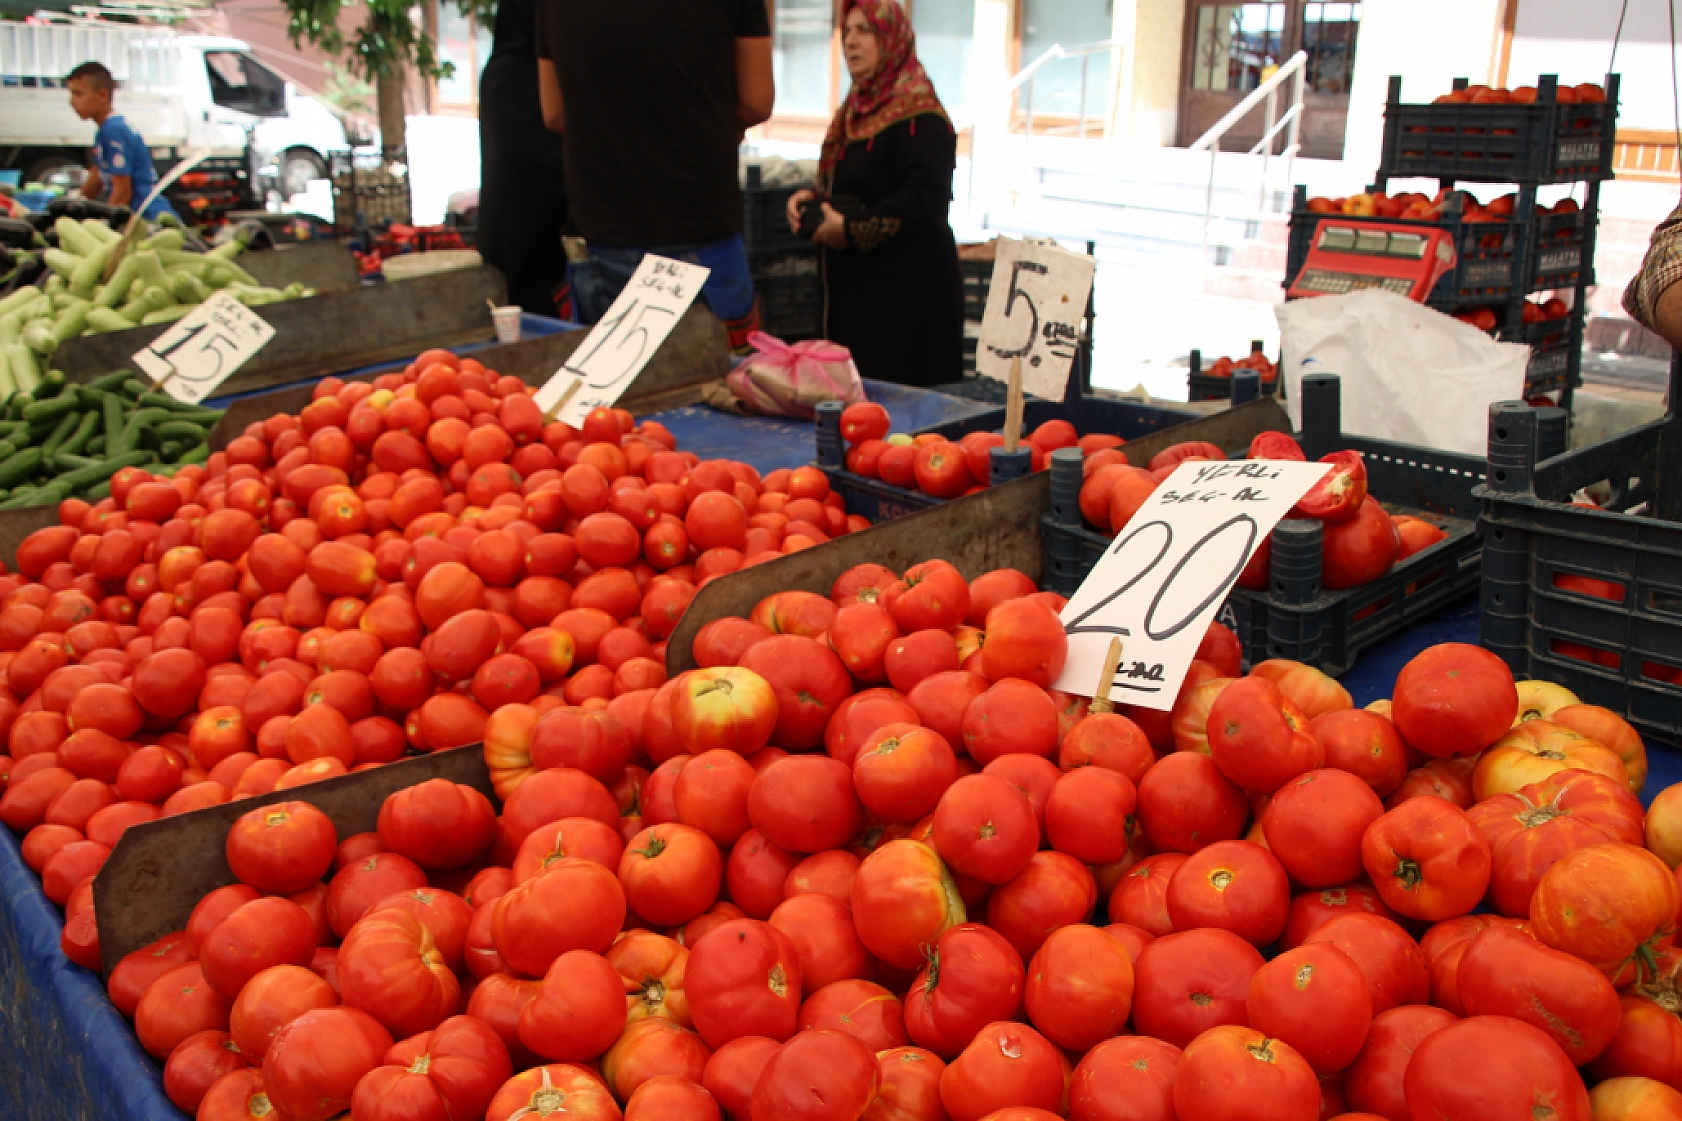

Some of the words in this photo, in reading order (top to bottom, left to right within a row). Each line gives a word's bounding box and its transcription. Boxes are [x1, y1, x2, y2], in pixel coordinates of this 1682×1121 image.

[148, 322, 239, 382] 15
[562, 298, 676, 389] 15
[1065, 512, 1258, 641] 20
